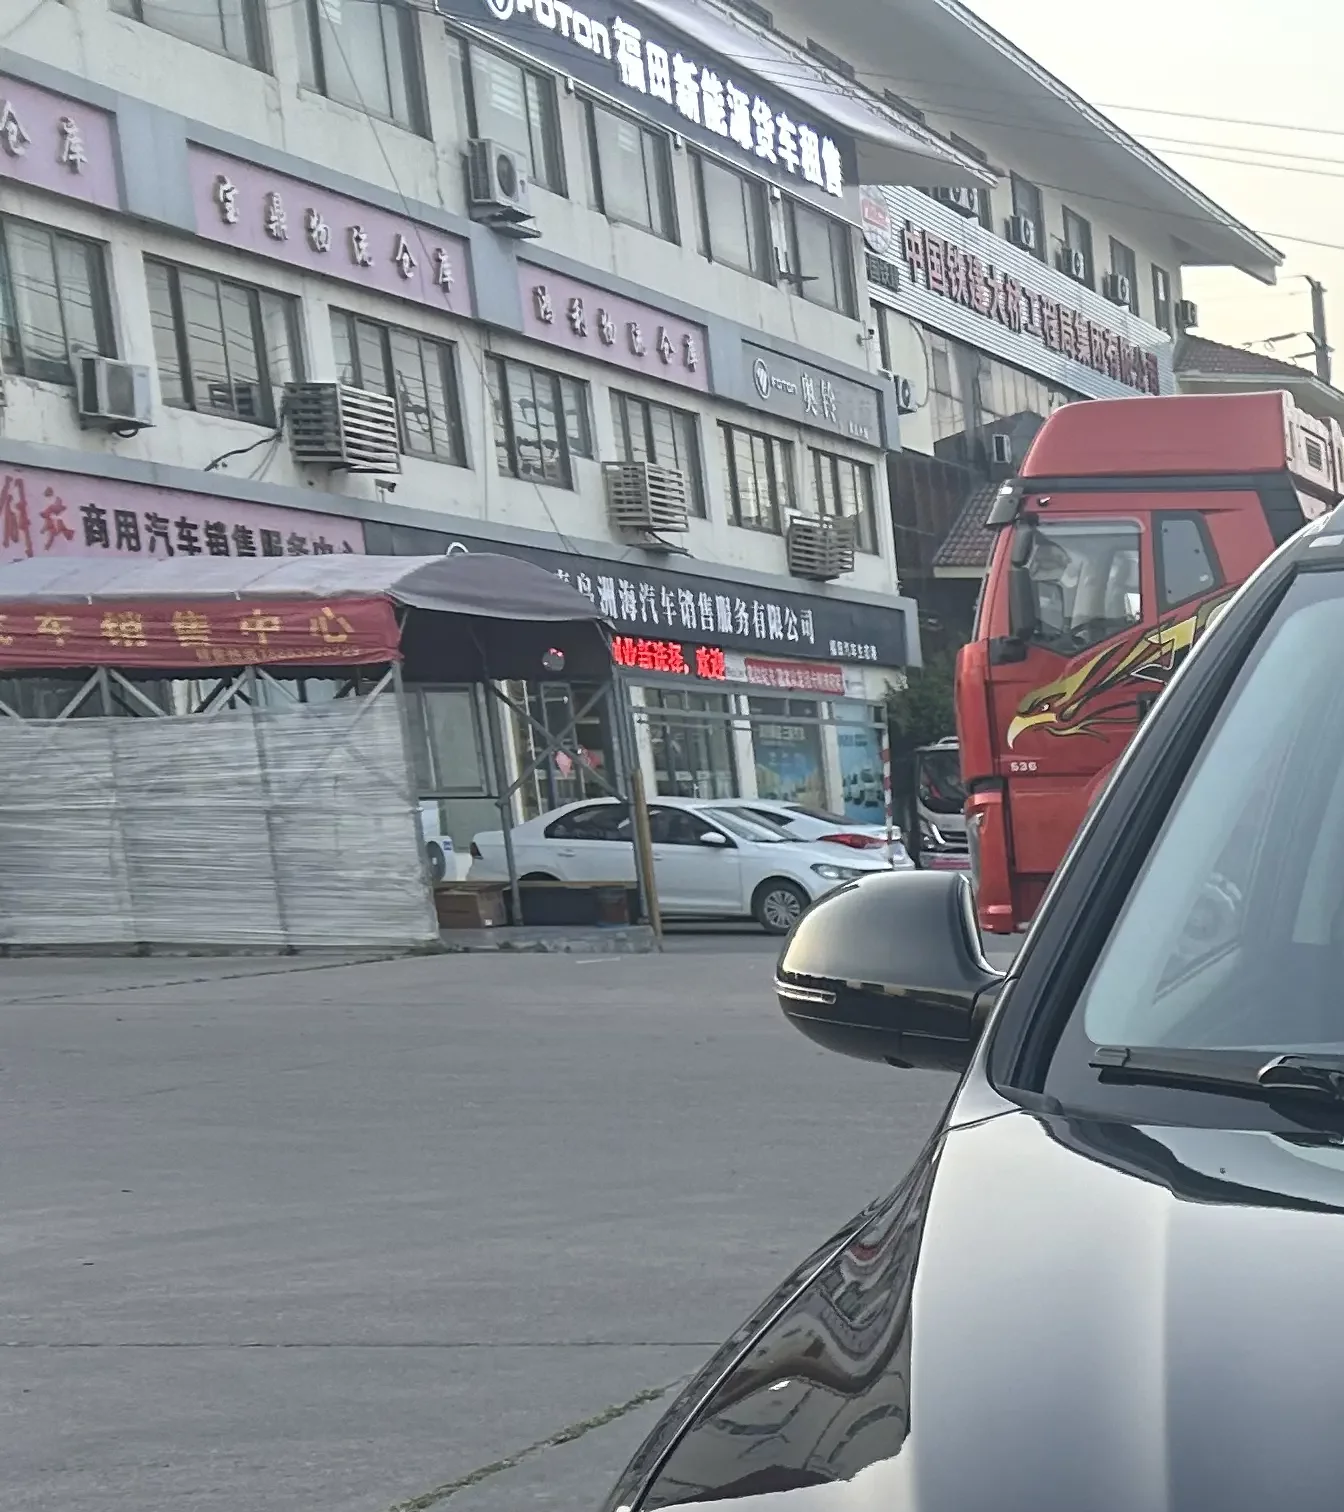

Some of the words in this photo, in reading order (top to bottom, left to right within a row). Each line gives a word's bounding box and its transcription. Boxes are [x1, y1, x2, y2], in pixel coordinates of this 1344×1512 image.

[0, 101, 88, 174] 仓库
[612, 16, 843, 198] 福田新能源货车租售
